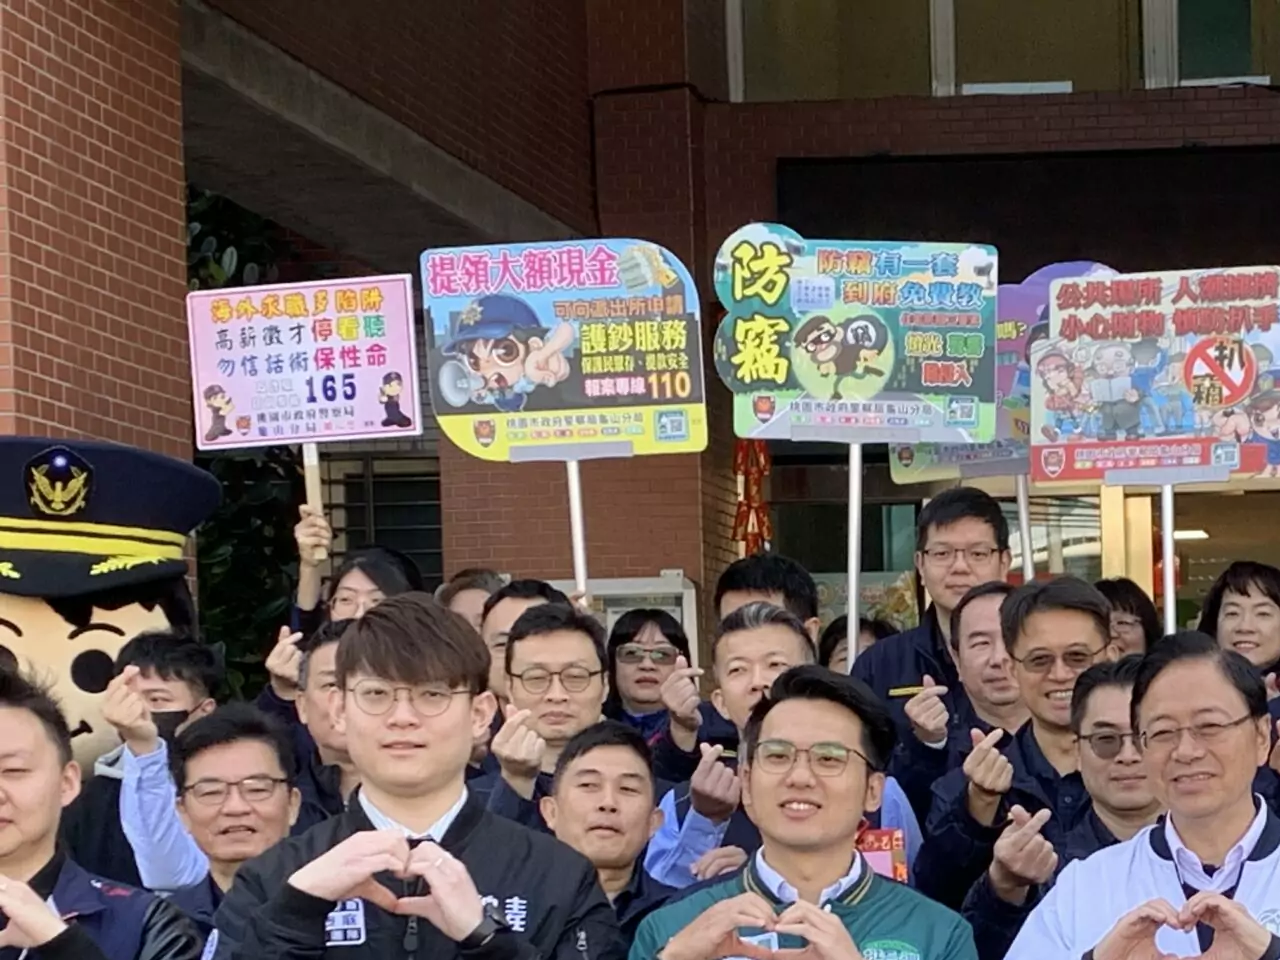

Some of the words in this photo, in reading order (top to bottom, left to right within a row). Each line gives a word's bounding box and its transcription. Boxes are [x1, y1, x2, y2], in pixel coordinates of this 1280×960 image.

[428, 245, 621, 296] 提領大額現金
[210, 287, 384, 323] 海外求職多陷阱
[732, 240, 793, 384] 防竊
[215, 315, 386, 350] 高薪徵才停看聽
[581, 320, 688, 355] 護鈔服務
[217, 344, 387, 377] 勿信話術保性命
[305, 373, 357, 403] 165
[647, 371, 691, 399] 110
